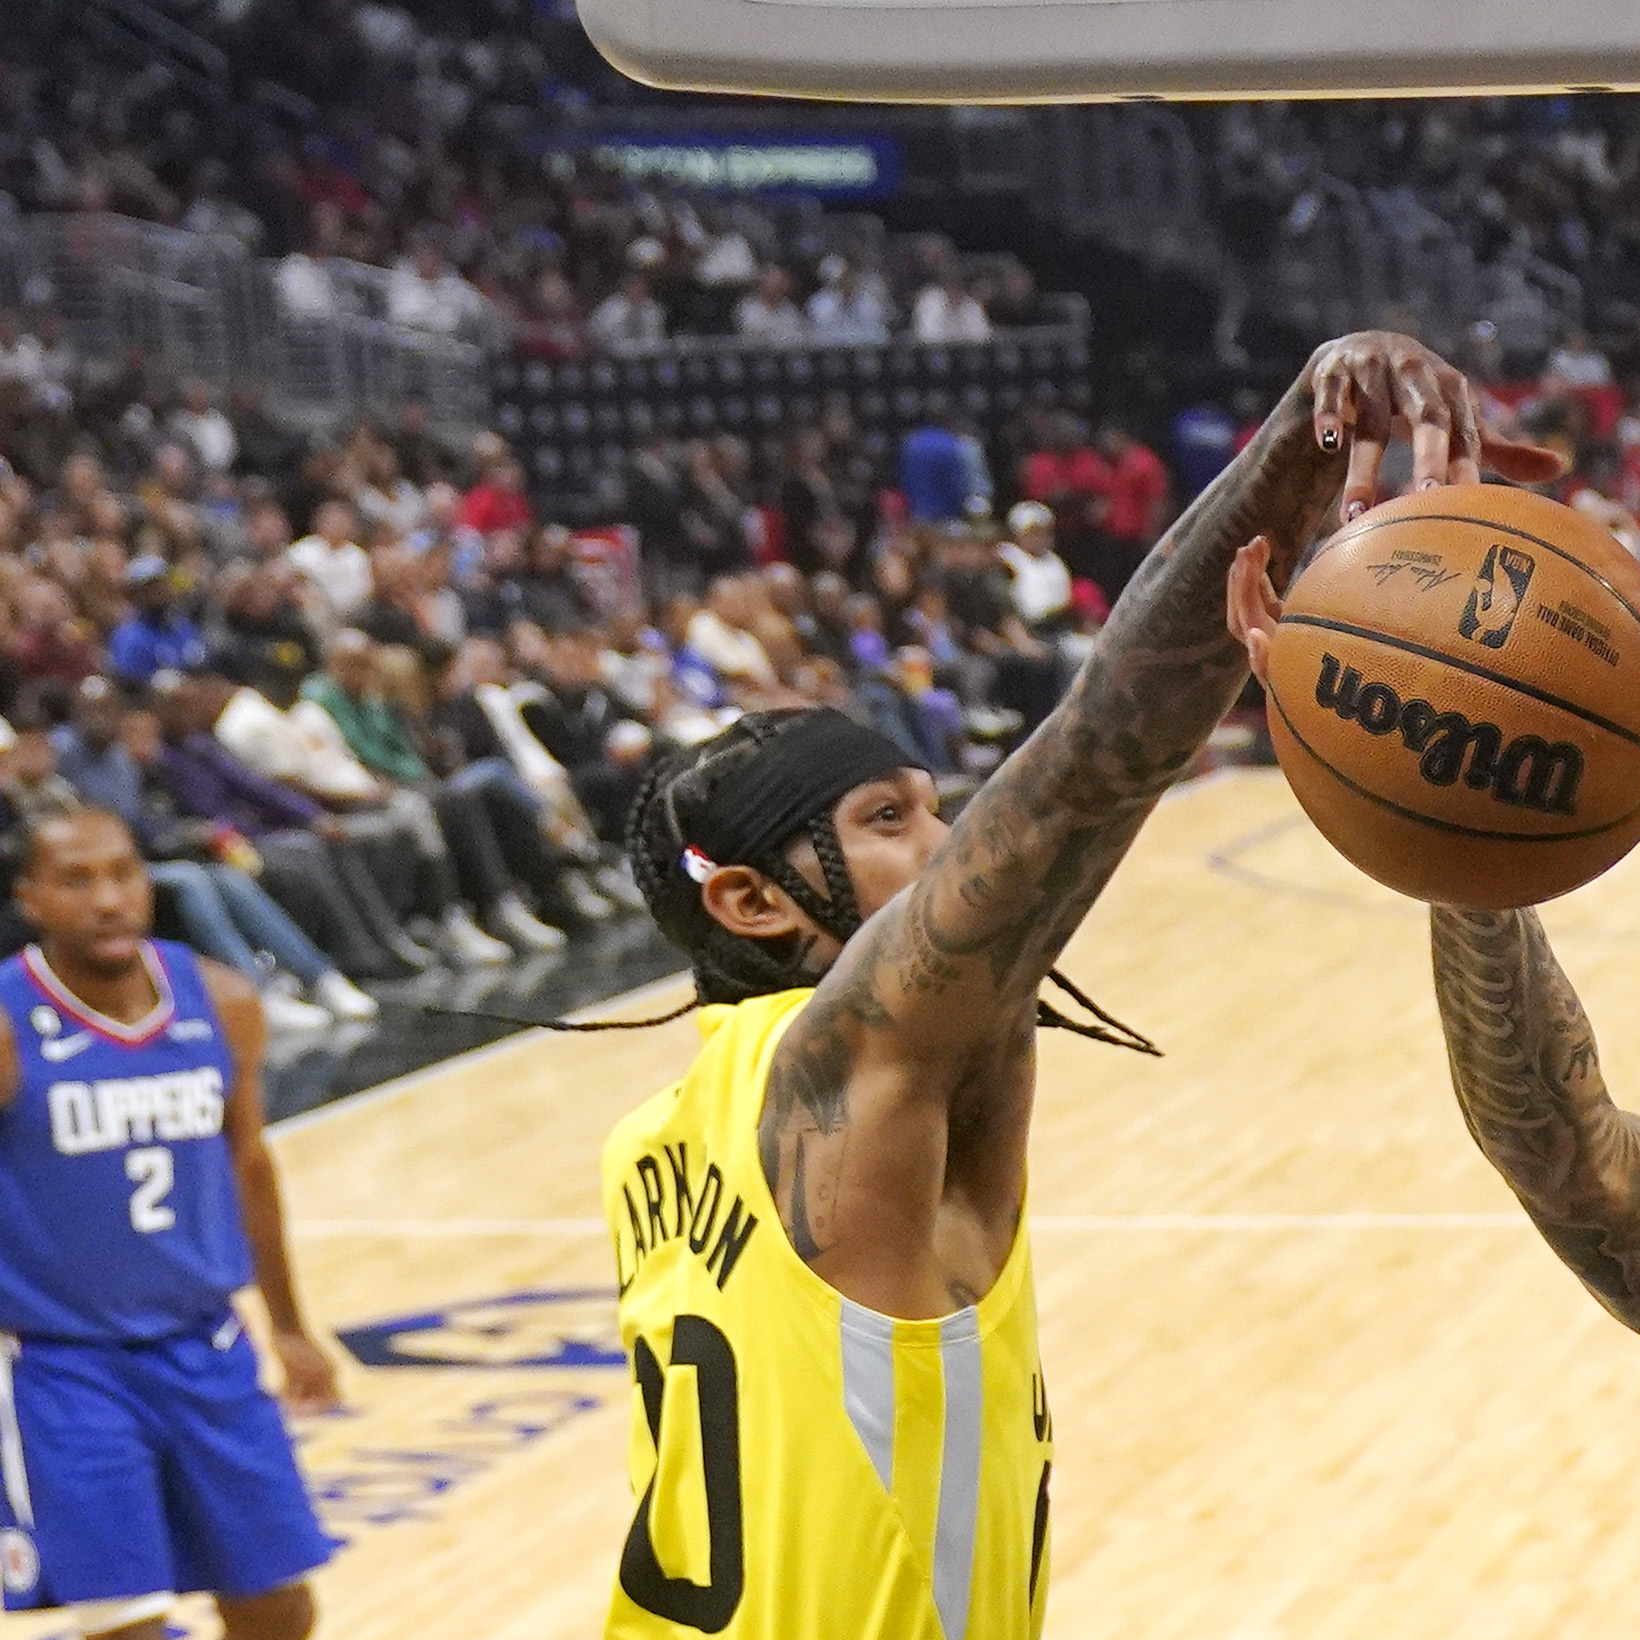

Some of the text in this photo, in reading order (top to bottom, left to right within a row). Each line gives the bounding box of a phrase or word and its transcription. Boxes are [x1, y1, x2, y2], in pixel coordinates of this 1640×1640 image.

[1537, 604, 1560, 627] BALL
[49, 1067, 224, 1156] CLIPPERS
[124, 1146, 176, 1234] 2
